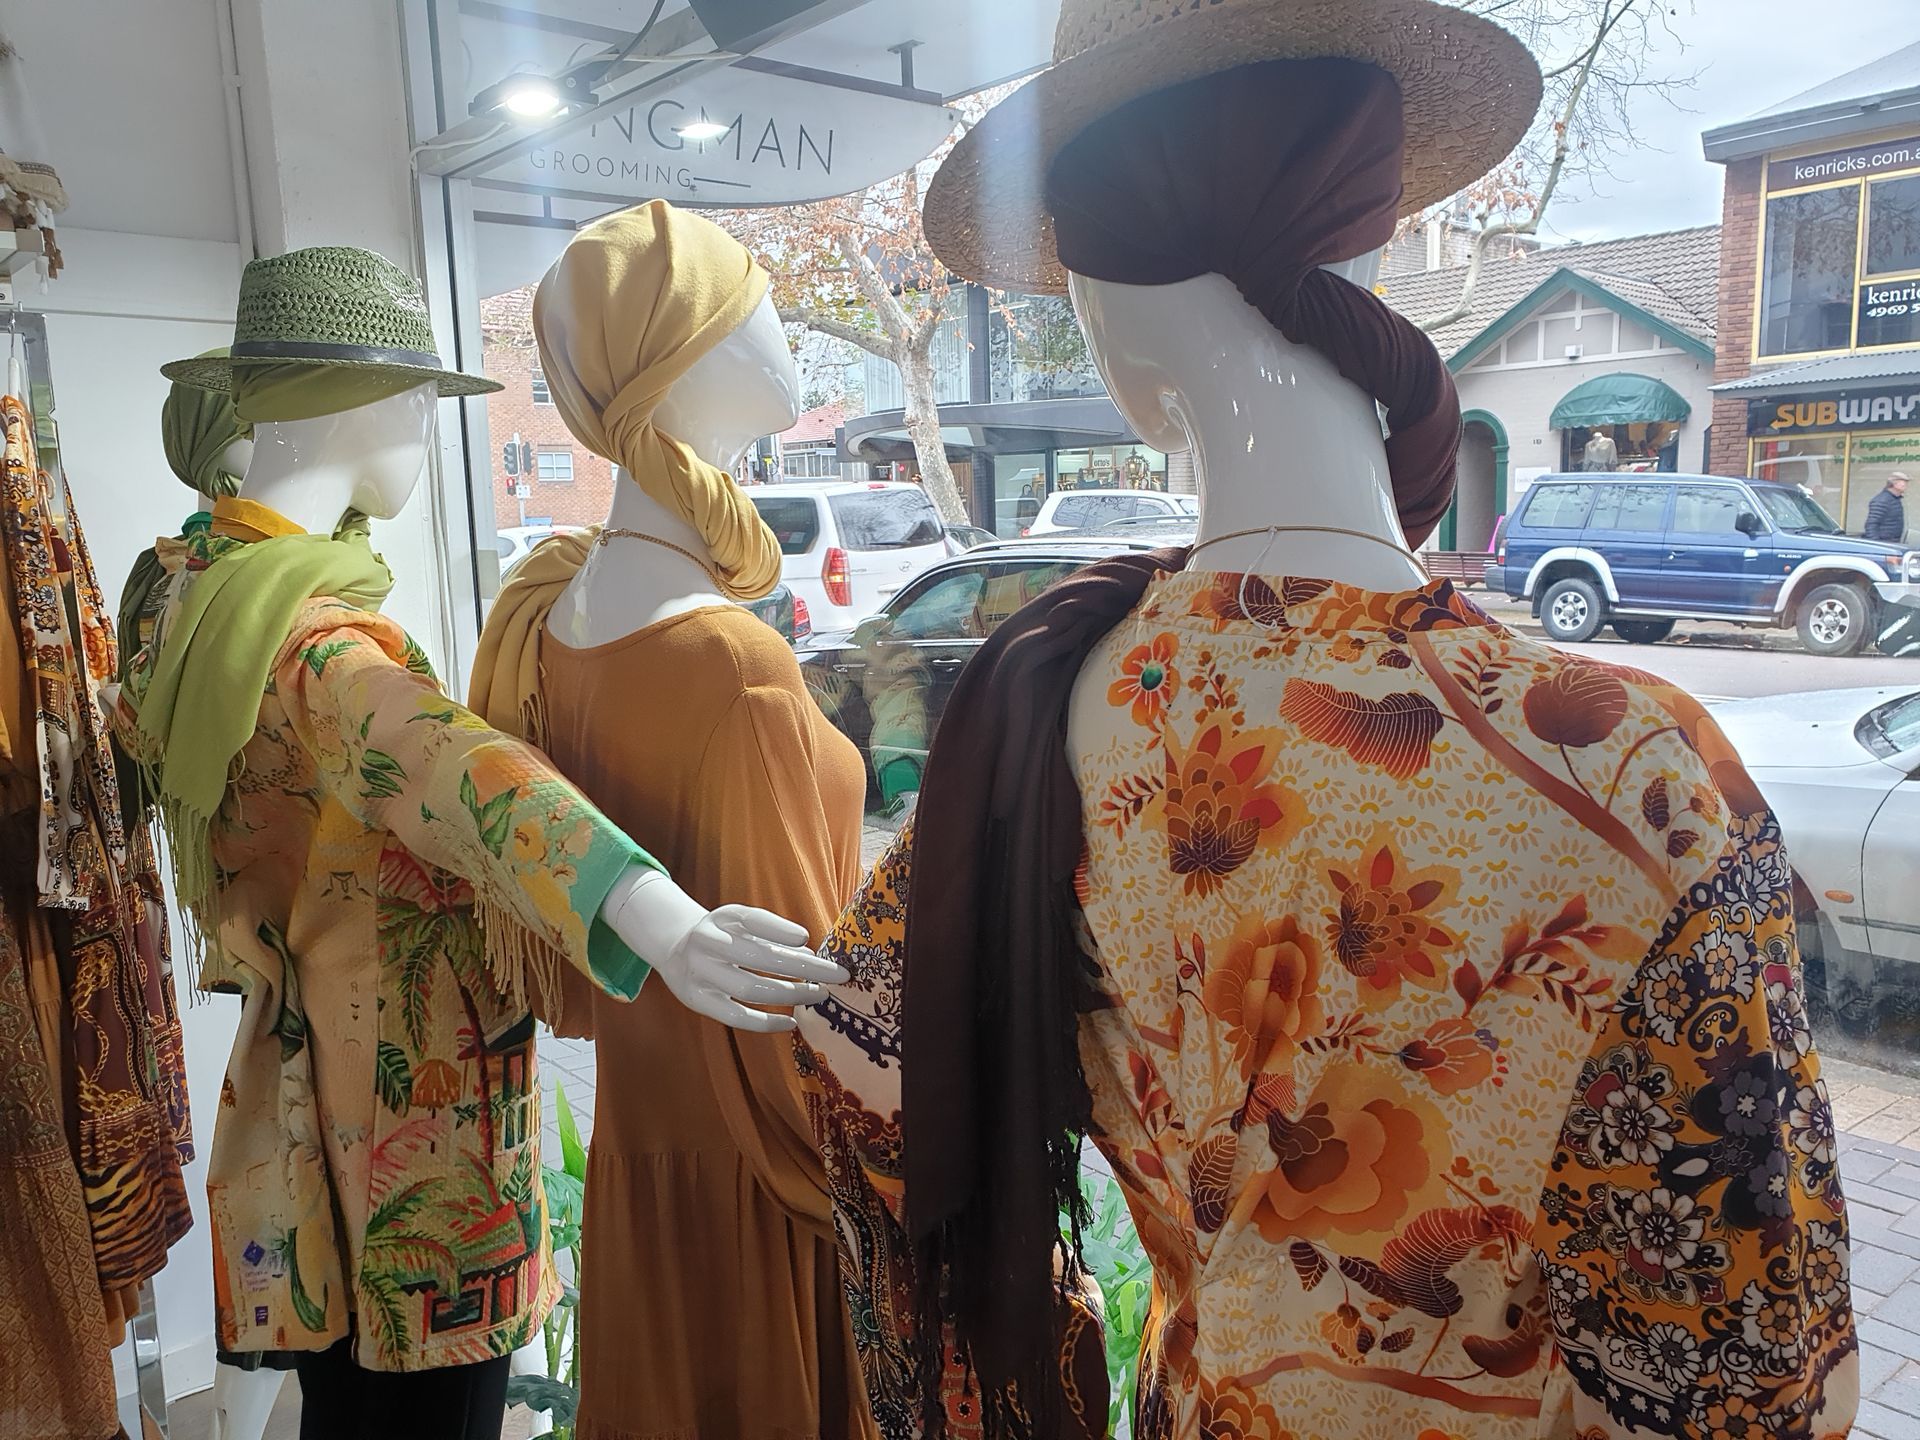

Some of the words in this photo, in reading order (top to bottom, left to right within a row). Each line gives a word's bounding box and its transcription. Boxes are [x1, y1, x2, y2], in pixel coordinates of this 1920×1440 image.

[530, 149, 691, 187] GROOMING
[1866, 304, 1908, 317] 4969
[1770, 395, 1920, 430] SUBWAY
